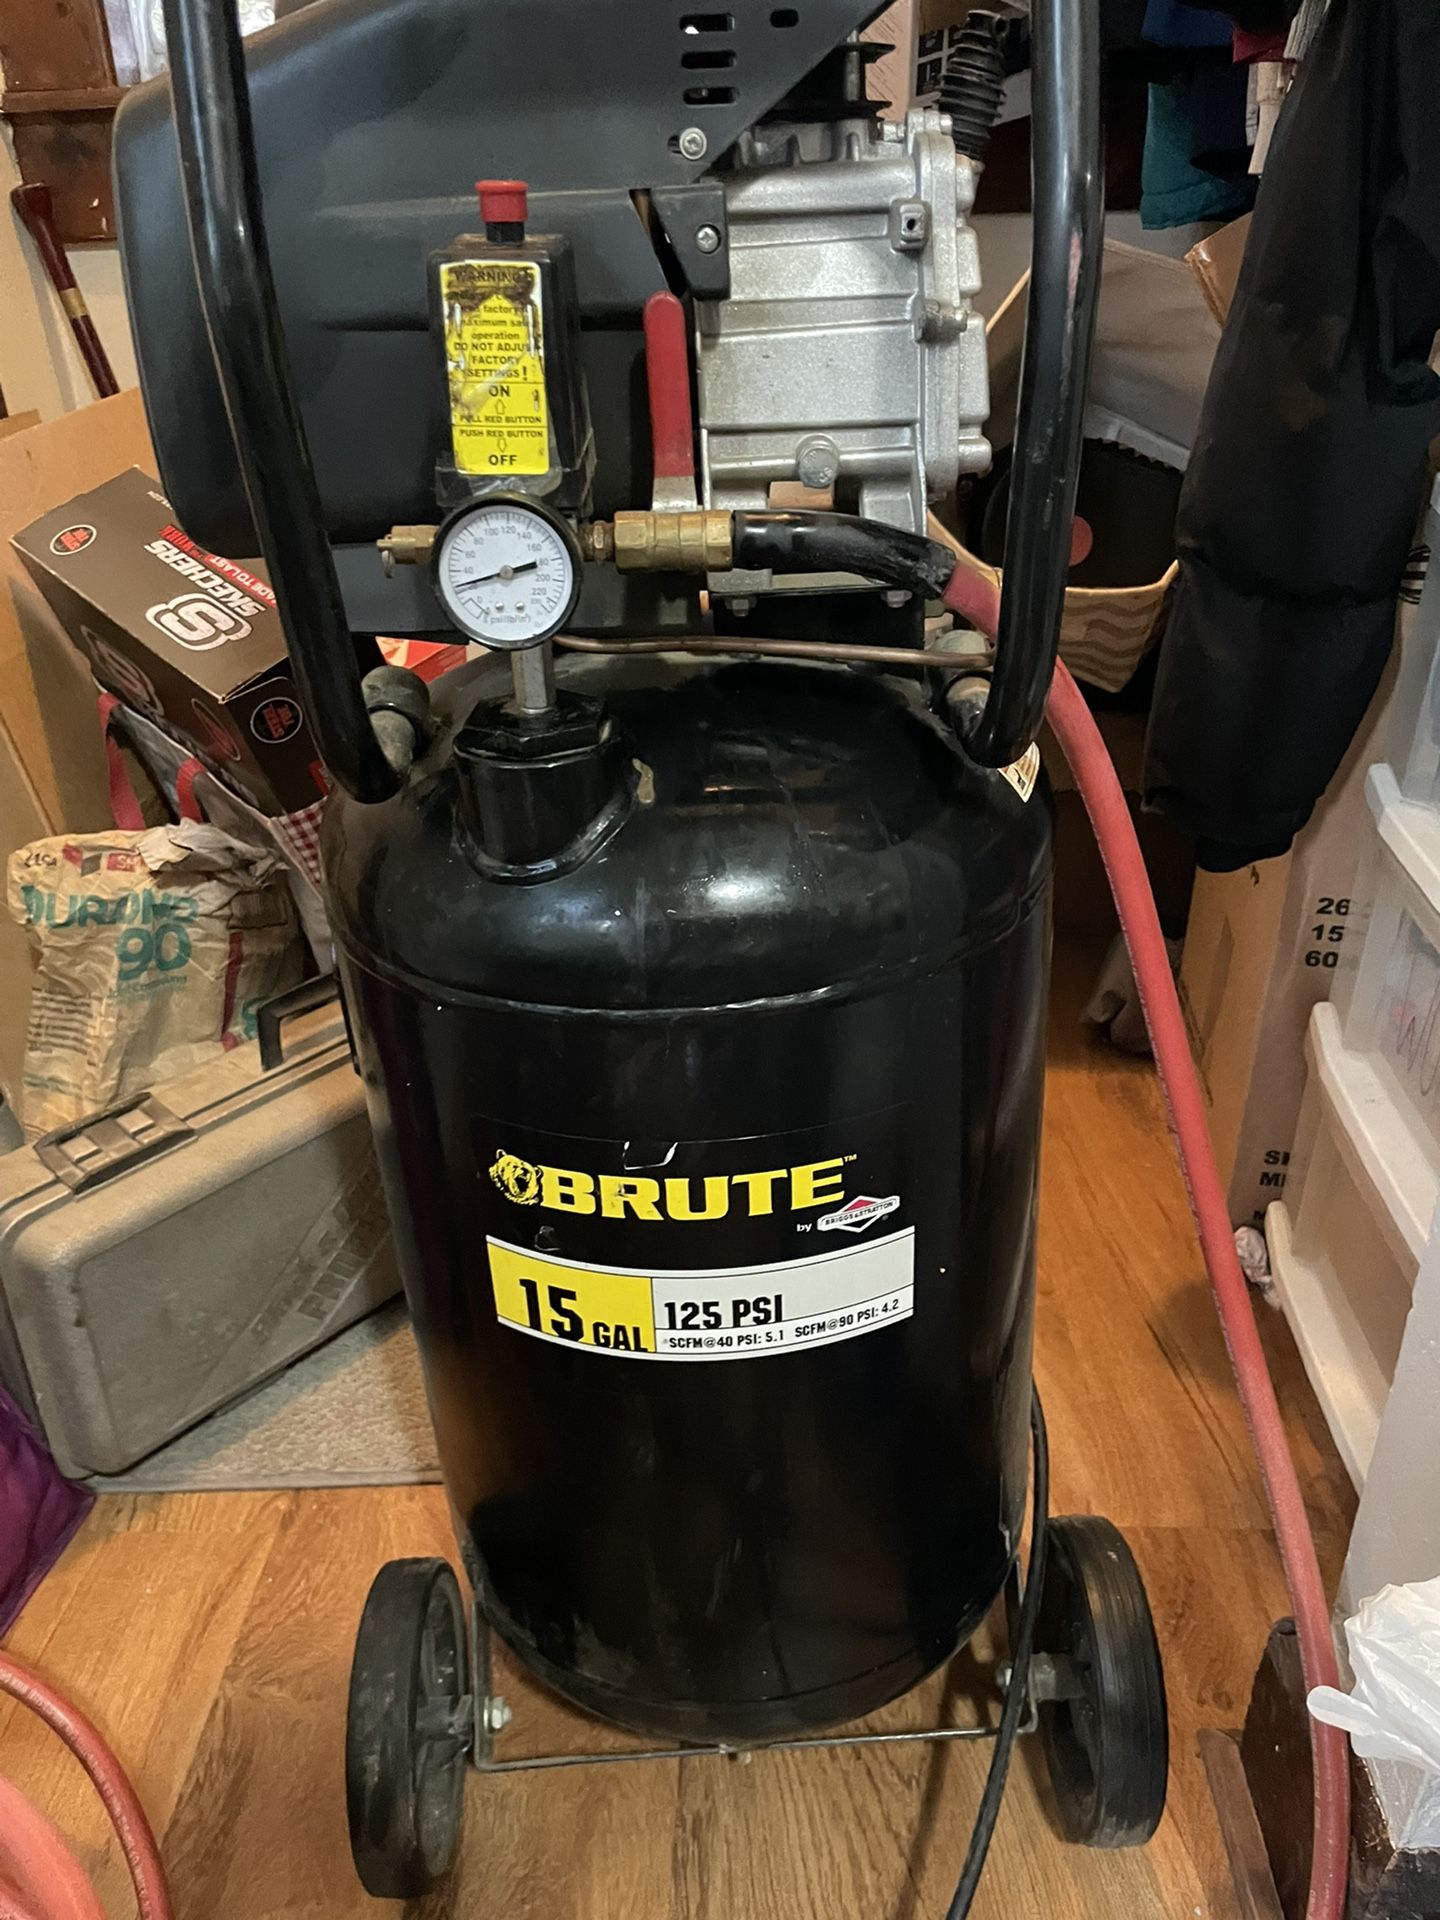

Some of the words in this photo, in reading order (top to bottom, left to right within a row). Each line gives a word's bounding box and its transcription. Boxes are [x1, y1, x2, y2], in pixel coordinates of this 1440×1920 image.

[472, 331, 520, 341] operation
[454, 342, 468, 351] DO
[472, 342, 494, 351] NOT
[471, 356, 520, 365] FACTORY
[489, 385, 510, 397] ON
[460, 429, 484, 437] PUSH
[506, 430, 543, 438] BUTTON
[488, 454, 517, 466] OFF
[484, 528, 499, 536] 100
[501, 526, 517, 534] 120
[517, 532, 532, 540] 140
[527, 543, 542, 552] 160
[144, 539, 267, 617] SKECHERS
[535, 574, 551, 582] 200
[1315, 898, 1351, 916] 26
[1311, 924, 1345, 942] 15
[117, 923, 192, 981] 90
[1304, 951, 1339, 968] 60
[537, 1158, 844, 1221] BRUTE
[796, 1223, 812, 1232] by
[519, 1278, 584, 1342] 15
[592, 1322, 648, 1352] GAL
[664, 1301, 722, 1329] 125
[732, 1294, 783, 1329] PSI
[669, 1335, 733, 1349] SCFM@40
[737, 1333, 762, 1346] PSI:
[765, 1330, 784, 1343] 5.1
[794, 1316, 854, 1338] SCFM@90
[857, 1307, 879, 1326] PSI:
[881, 1299, 899, 1314] 4.2
